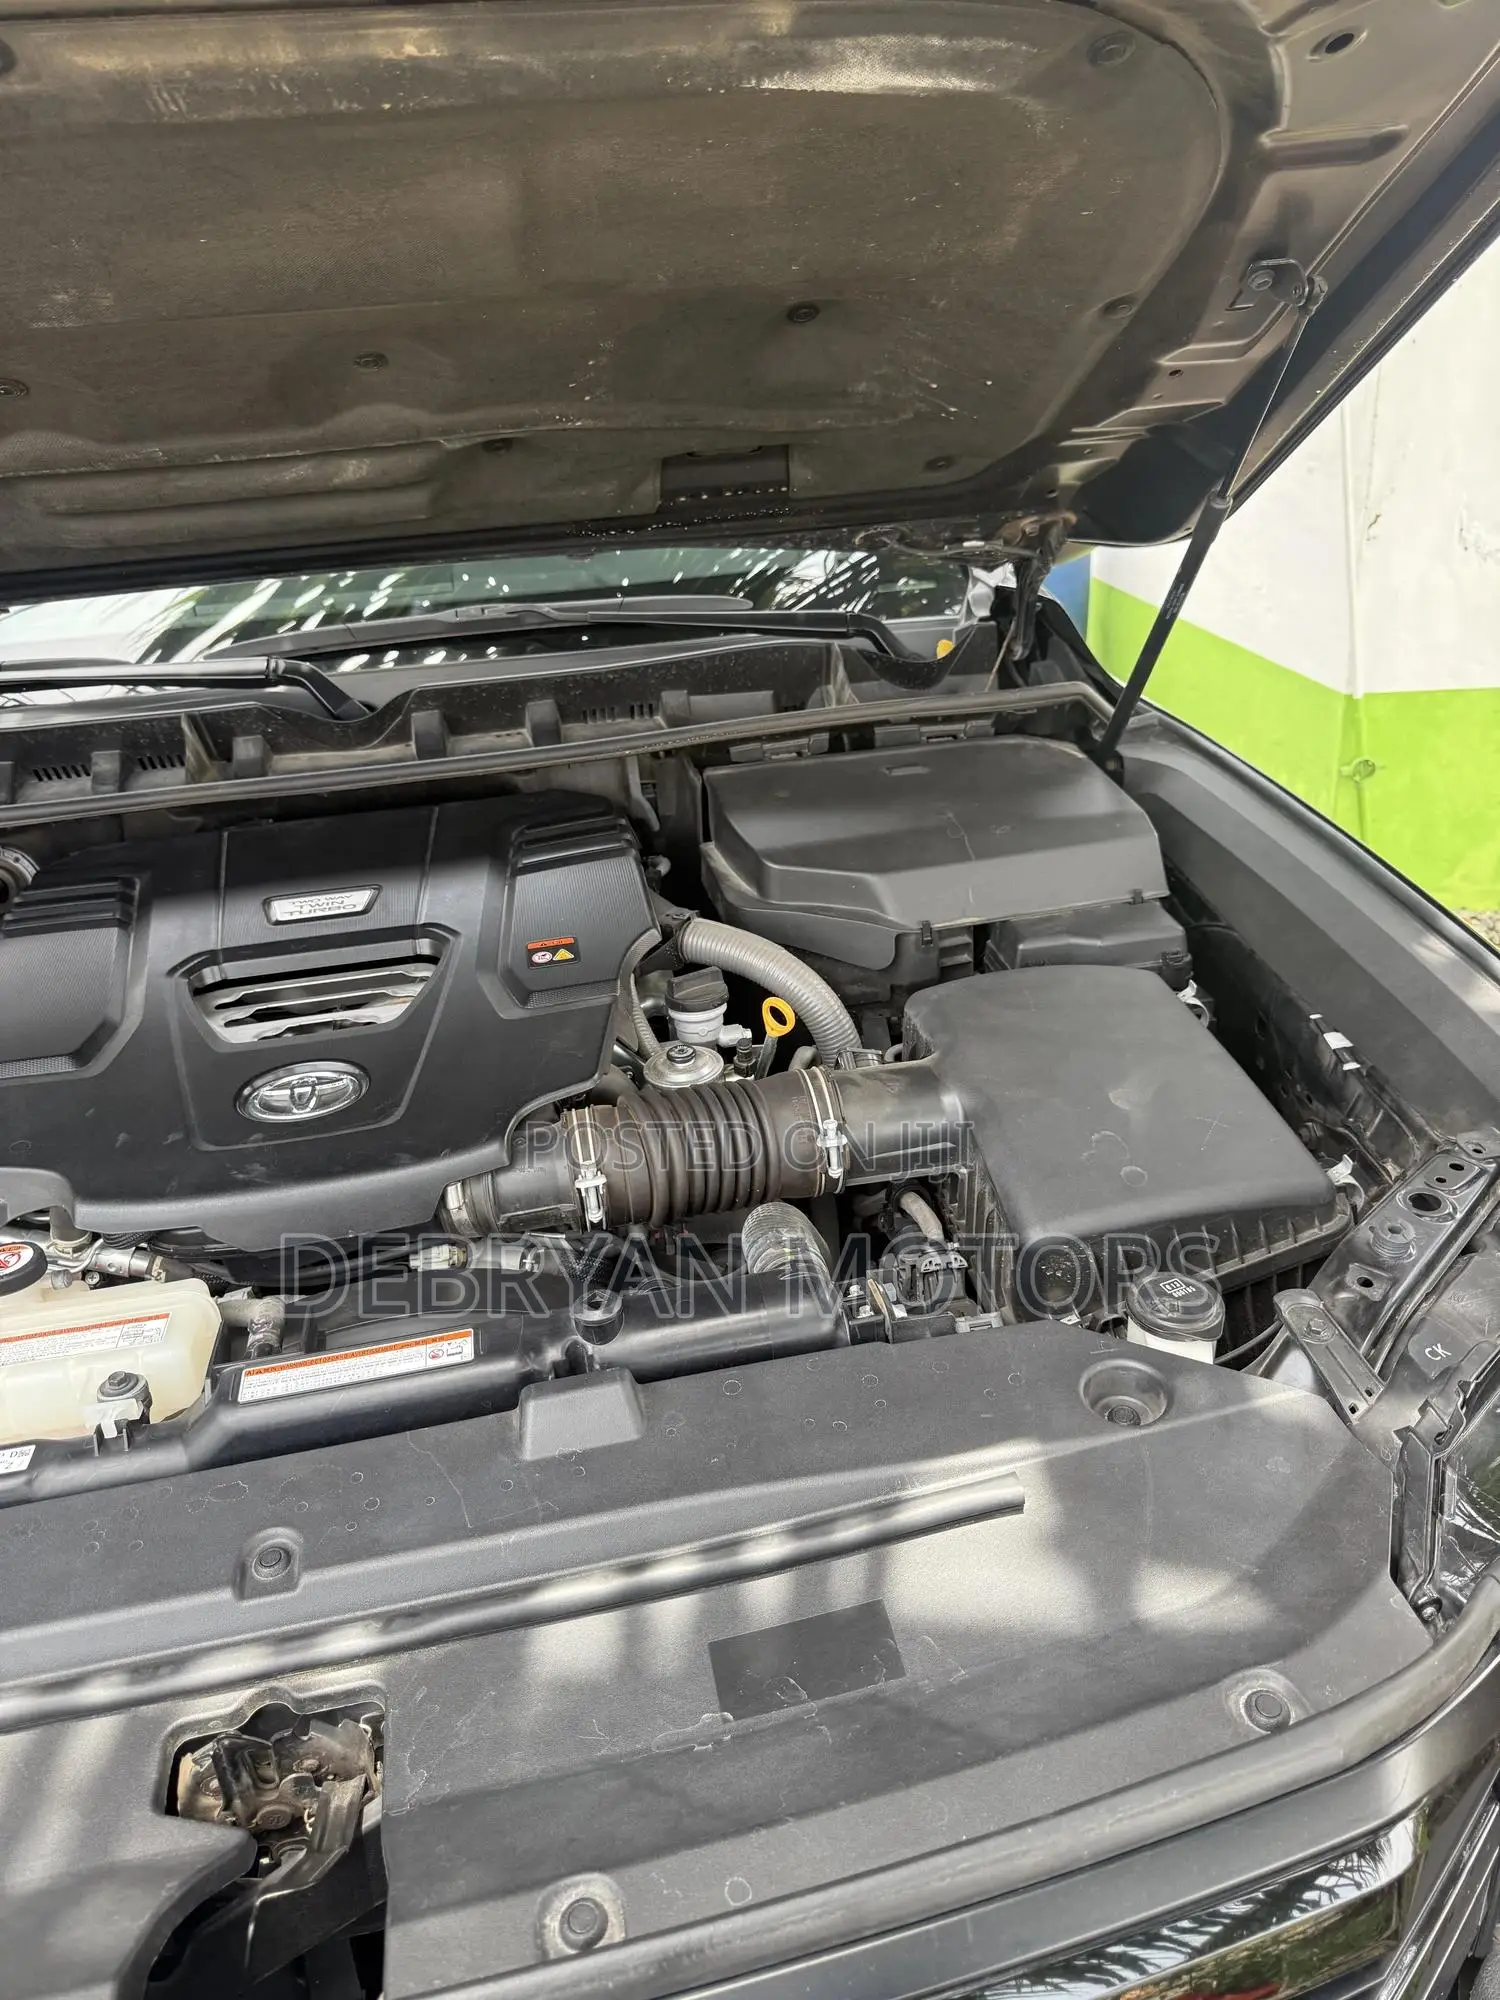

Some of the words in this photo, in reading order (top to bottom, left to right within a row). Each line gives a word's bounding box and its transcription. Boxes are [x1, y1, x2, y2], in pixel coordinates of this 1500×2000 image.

[283, 903, 357, 917] TURBO
[294, 899, 345, 910] TWIN
[1424, 1343, 1452, 1361] CK
